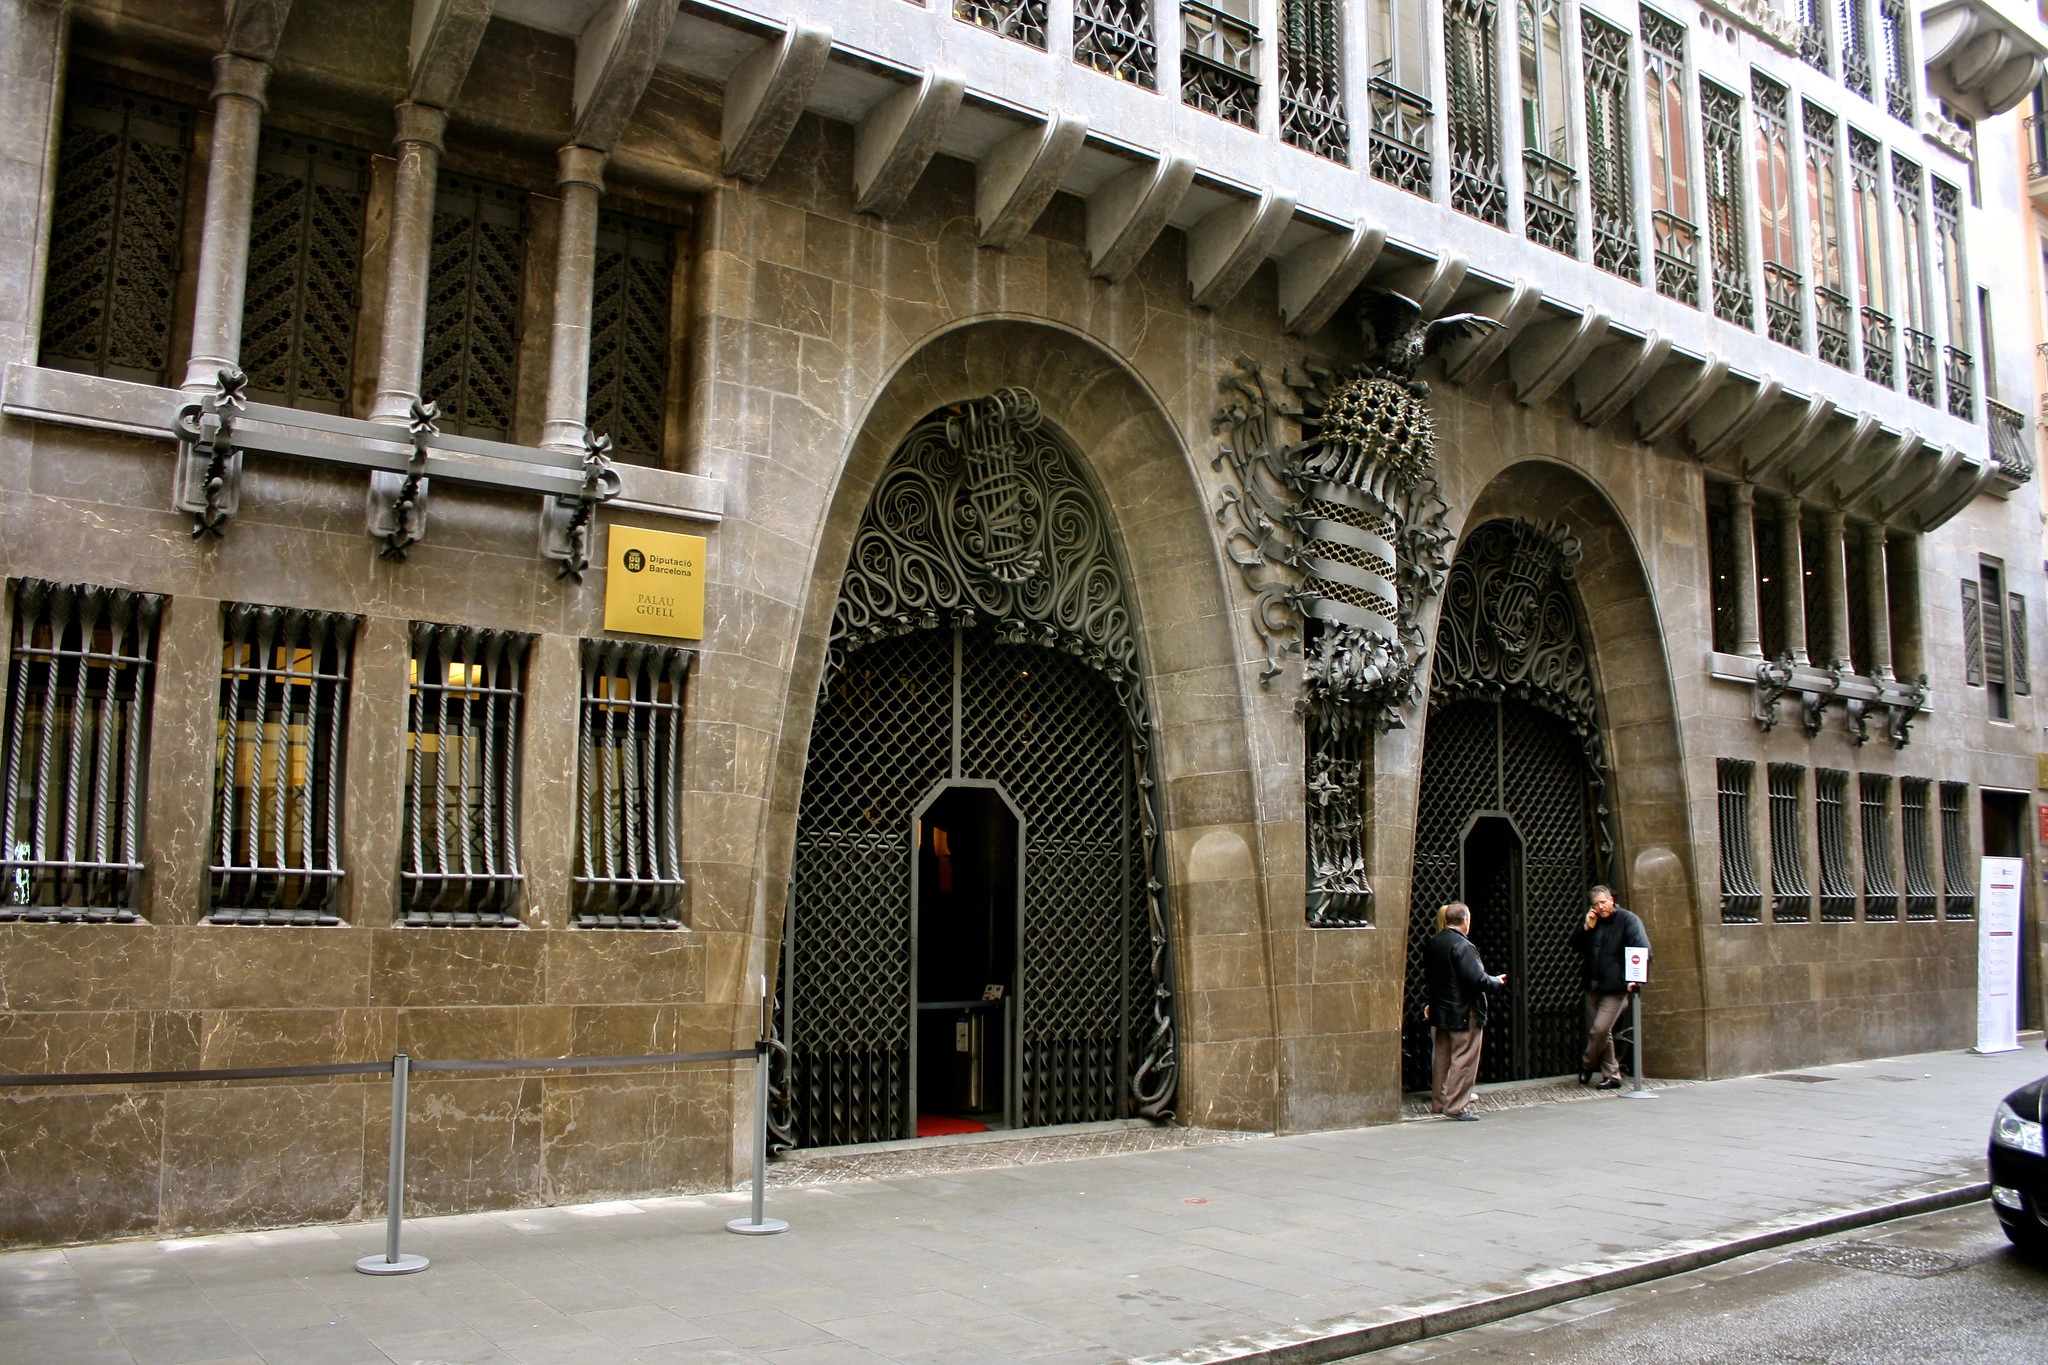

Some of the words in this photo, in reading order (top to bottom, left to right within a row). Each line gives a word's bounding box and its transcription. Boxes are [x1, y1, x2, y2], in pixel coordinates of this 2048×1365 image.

[649, 555, 692, 568] Diputació
[649, 564, 692, 577] Barcelona
[638, 594, 674, 606] PALAU
[636, 605, 674, 618] GÜELL
